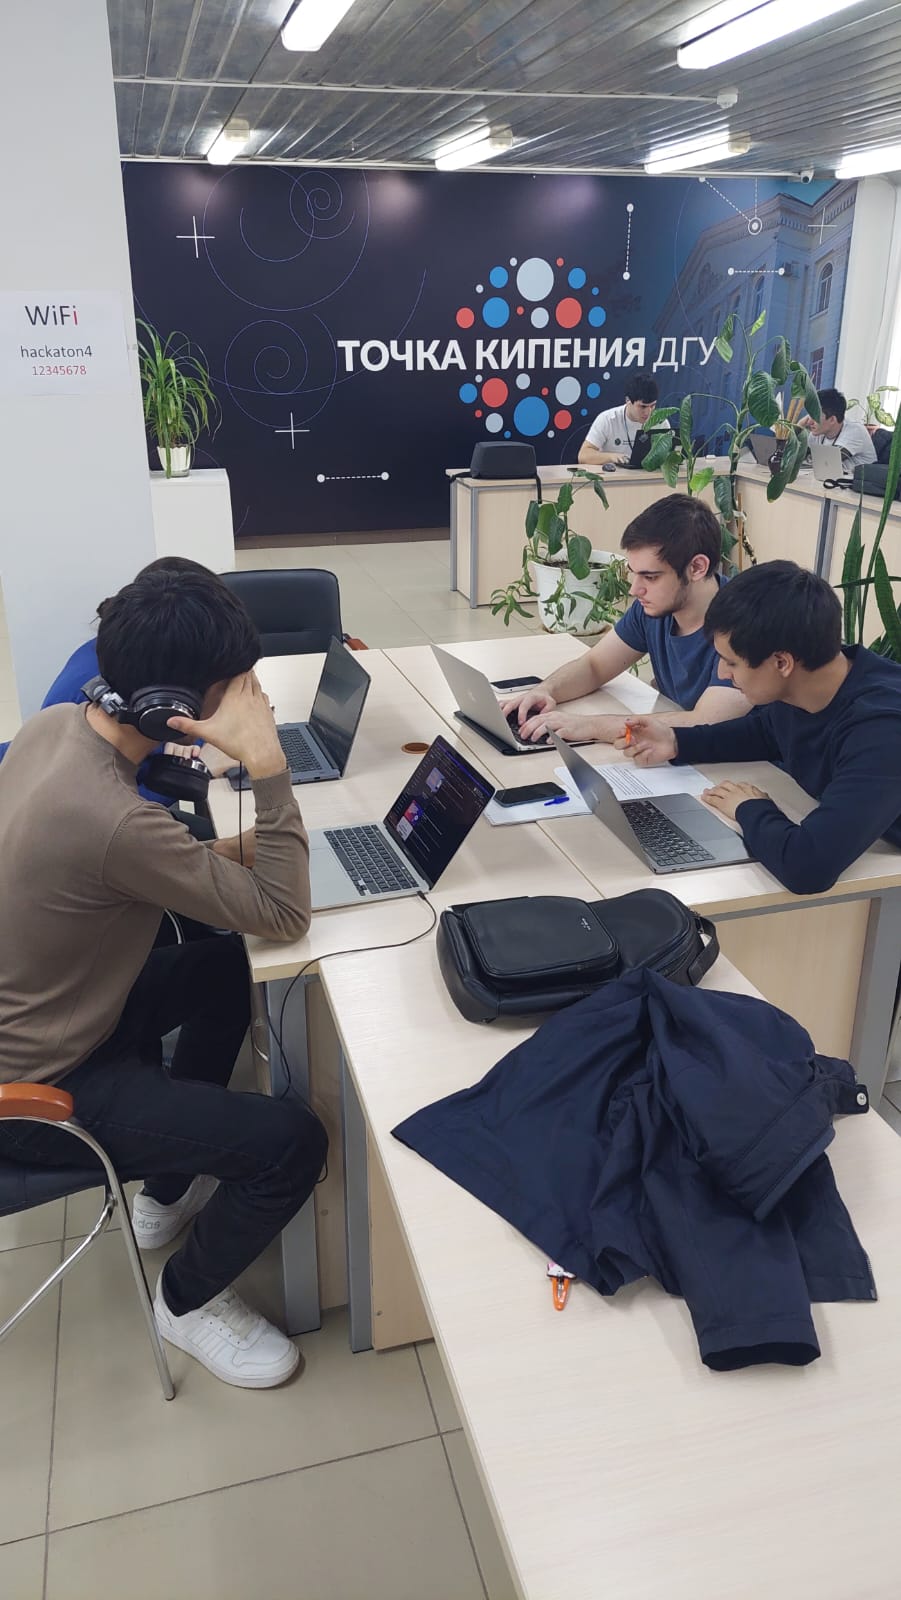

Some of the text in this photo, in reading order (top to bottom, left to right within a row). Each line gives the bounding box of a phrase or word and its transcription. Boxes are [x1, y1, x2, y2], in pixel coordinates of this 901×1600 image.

[24, 304, 78, 326] WiFi
[20, 344, 92, 358] hackaton4
[337, 336, 718, 373] ТОЧКА КИПЕНИЯ ДГУ
[32, 365, 87, 376] 12345678
